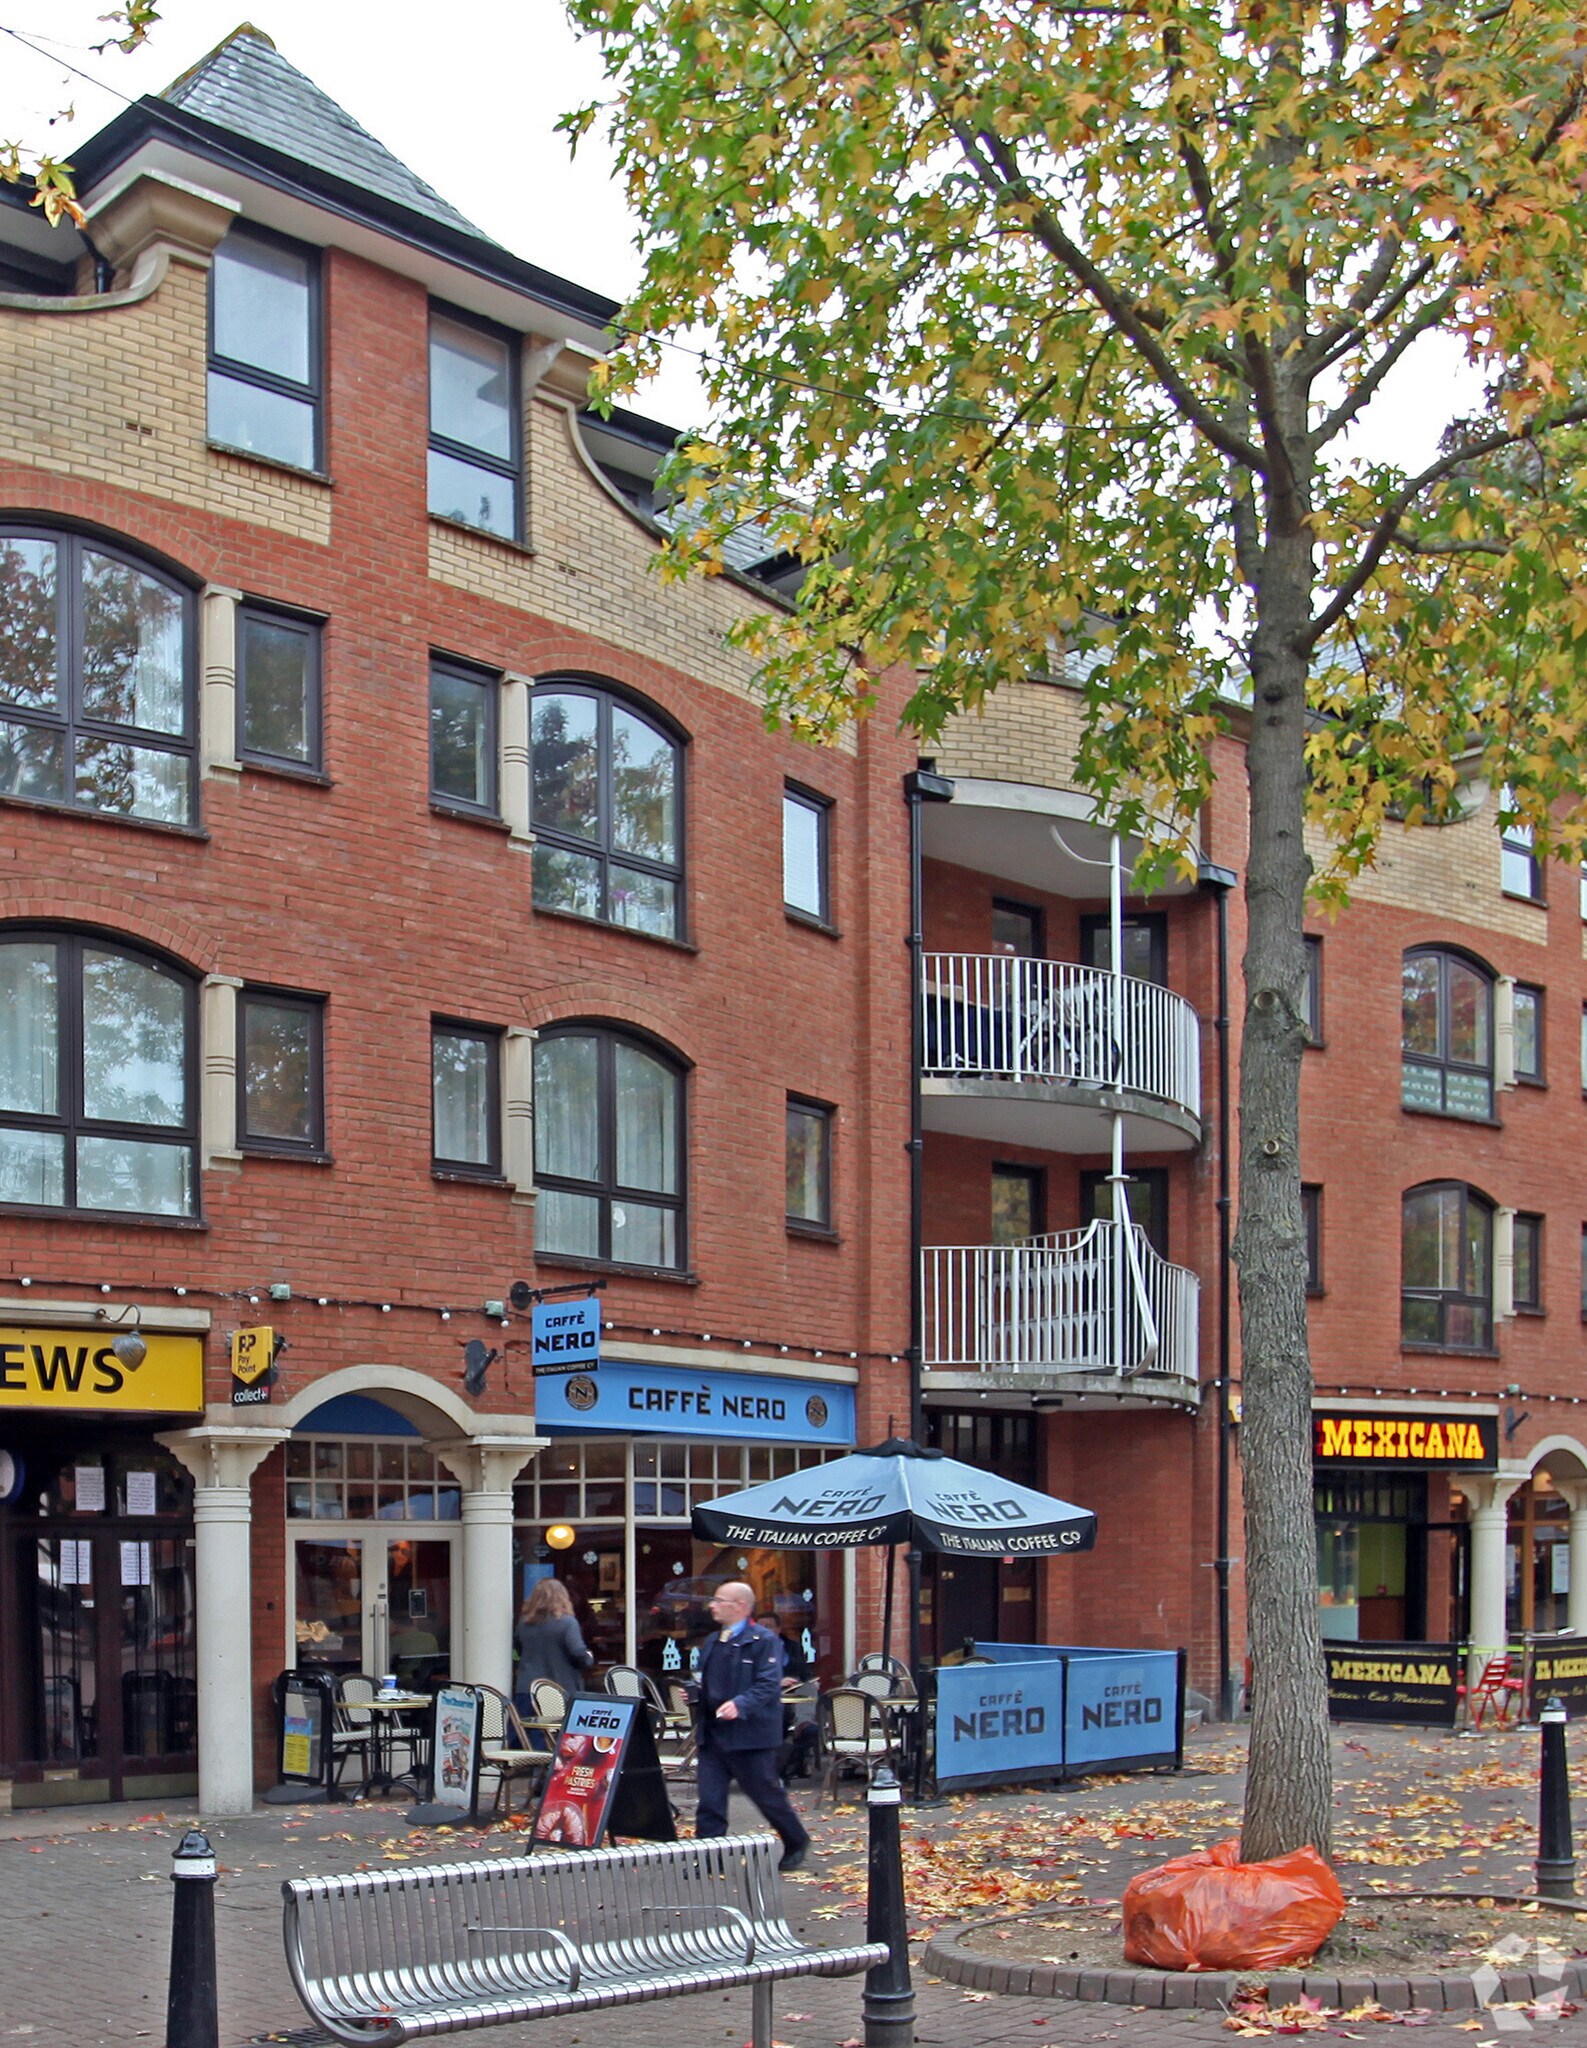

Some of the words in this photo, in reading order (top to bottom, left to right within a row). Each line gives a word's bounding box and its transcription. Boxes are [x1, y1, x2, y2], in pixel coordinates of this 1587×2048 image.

[545, 1311, 585, 1328] CAFFÈ
[535, 1331, 595, 1353] NERO
[238, 1355, 251, 1365] Pay
[238, 1364, 257, 1374] Point
[628, 1384, 711, 1415] CAFFÈ
[722, 1395, 785, 1420] NERO
[1319, 1419, 1485, 1459] MEXICANA
[769, 1495, 887, 1517] NERO
[926, 1499, 1028, 1522] NERO
[726, 1525, 754, 1541] THE
[756, 1530, 812, 1546] ITALIAN
[813, 1529, 868, 1546] COFFEE
[940, 1532, 962, 1549] THE
[962, 1536, 1005, 1551] ITALIAN
[1007, 1535, 1059, 1551] COFFEE
[1331, 1660, 1452, 1685] MEXICANA
[980, 1690, 1023, 1707] CAFFÈ
[576, 1715, 622, 1730] NERO
[954, 1707, 1045, 1742] NERO
[1082, 1697, 1162, 1731] NERO
[571, 1766, 595, 1777] FRESH
